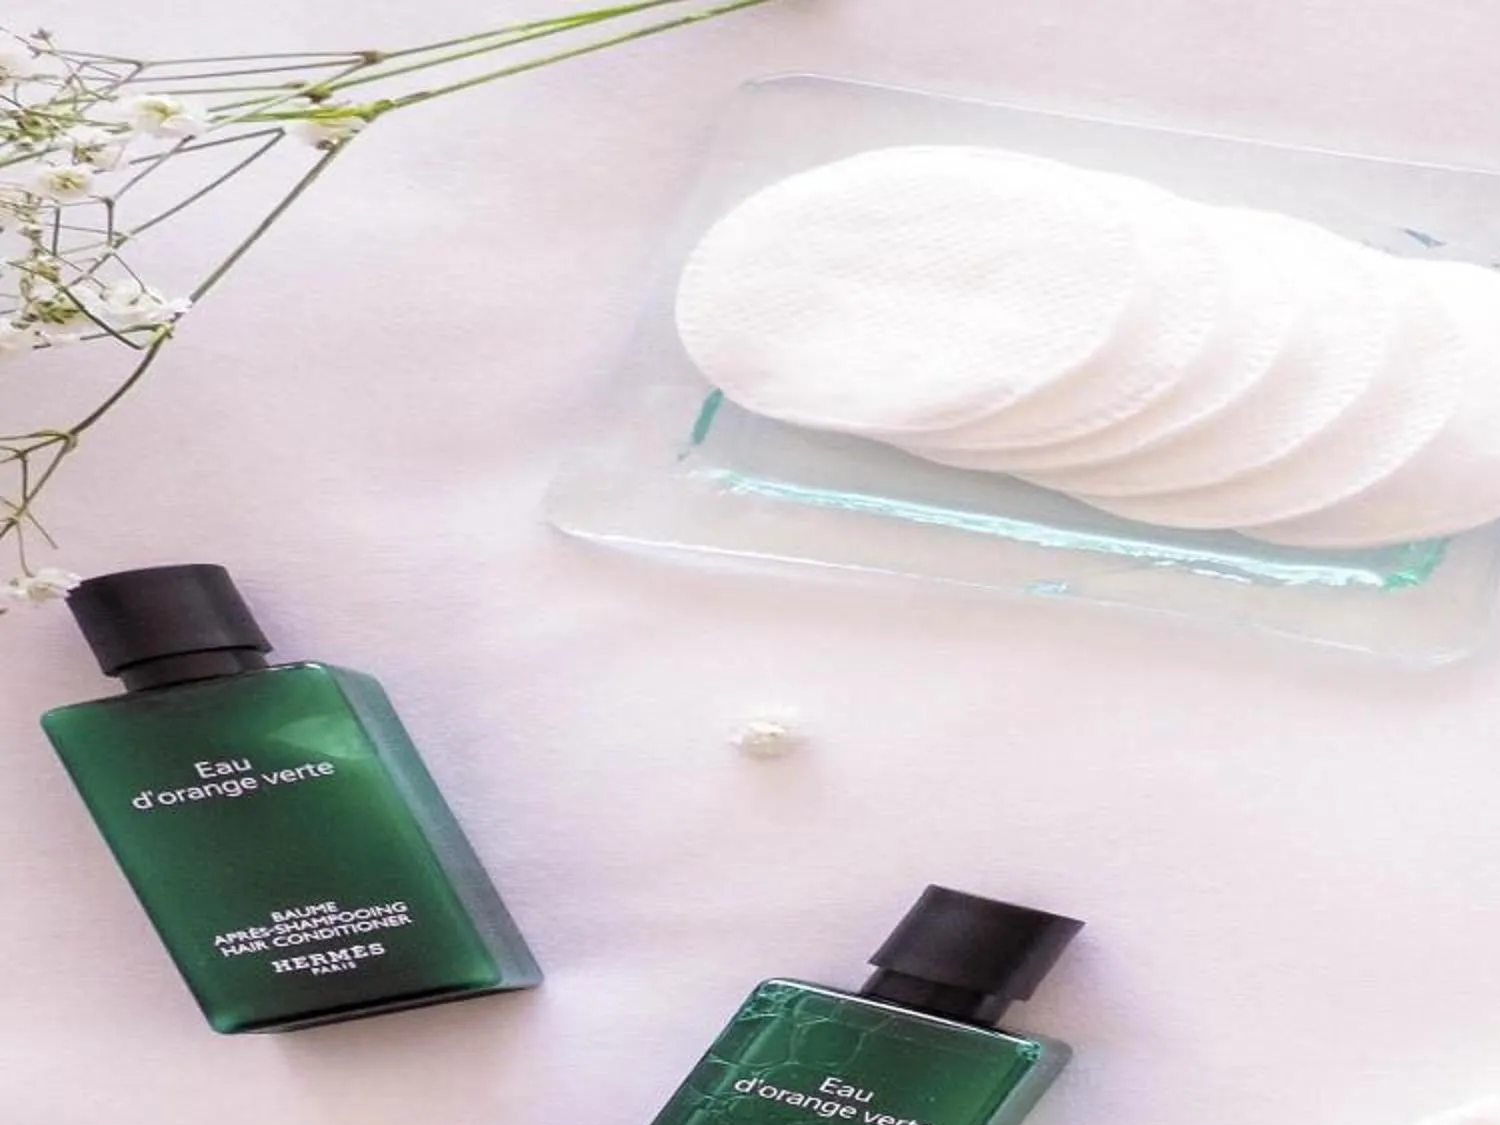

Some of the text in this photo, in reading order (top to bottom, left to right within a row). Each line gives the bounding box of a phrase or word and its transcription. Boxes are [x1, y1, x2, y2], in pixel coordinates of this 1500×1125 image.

[193, 757, 253, 779] Eau
[131, 760, 335, 810] d'orange verte
[271, 901, 339, 923] BAUME
[220, 914, 413, 957] HAIR CONDITIONER
[311, 962, 357, 976] PARIS
[734, 1077, 857, 1119] d'orange
[818, 1076, 875, 1103] Eau
